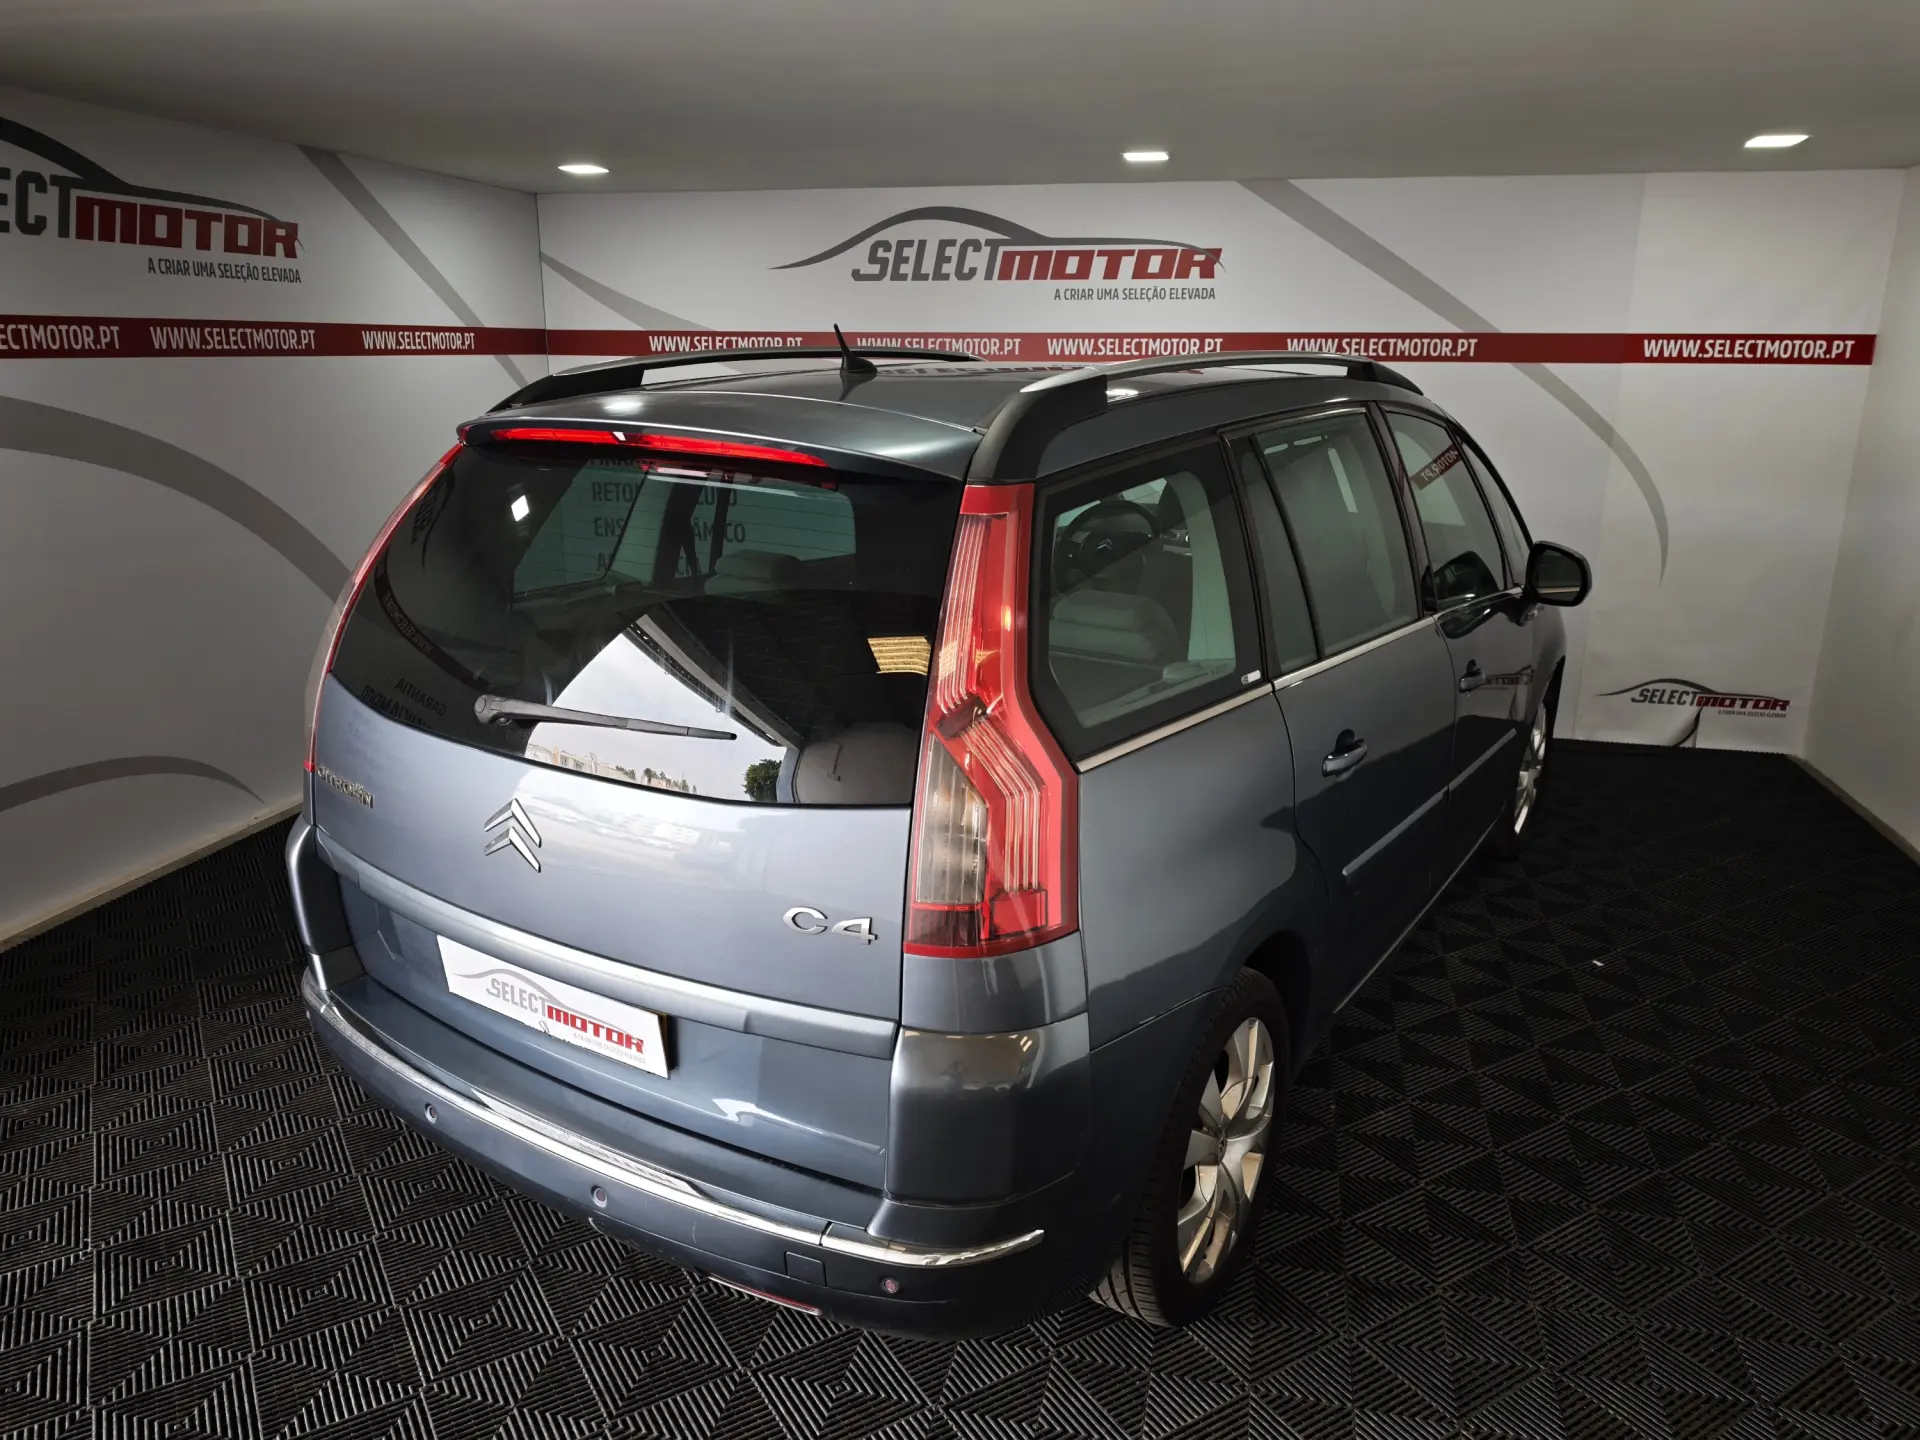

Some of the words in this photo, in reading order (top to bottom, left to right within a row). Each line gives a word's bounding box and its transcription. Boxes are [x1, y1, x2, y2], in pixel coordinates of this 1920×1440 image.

[148, 257, 156, 274] A
[158, 258, 191, 277] CRIAR
[192, 260, 217, 279] UMA
[218, 261, 260, 283] SELEÇÃO
[261, 266, 301, 284] ELEVADA
[1054, 288, 1061, 300] A
[1064, 288, 1094, 300] CRIAR
[1097, 288, 1119, 300] UMA
[1122, 286, 1166, 302] SELEÇÃO
[1169, 287, 1216, 300] ELEVADA
[149, 326, 315, 350] WWW.SELECTMOTOR.PT
[362, 330, 475, 350] WWW.SELECTMOTOR.PT
[648, 335, 803, 352] WWW.SELECTMOTORPT
[1643, 339, 1856, 359] WWW.SELECTMOTOR.PT
[782, 906, 878, 945] C4
